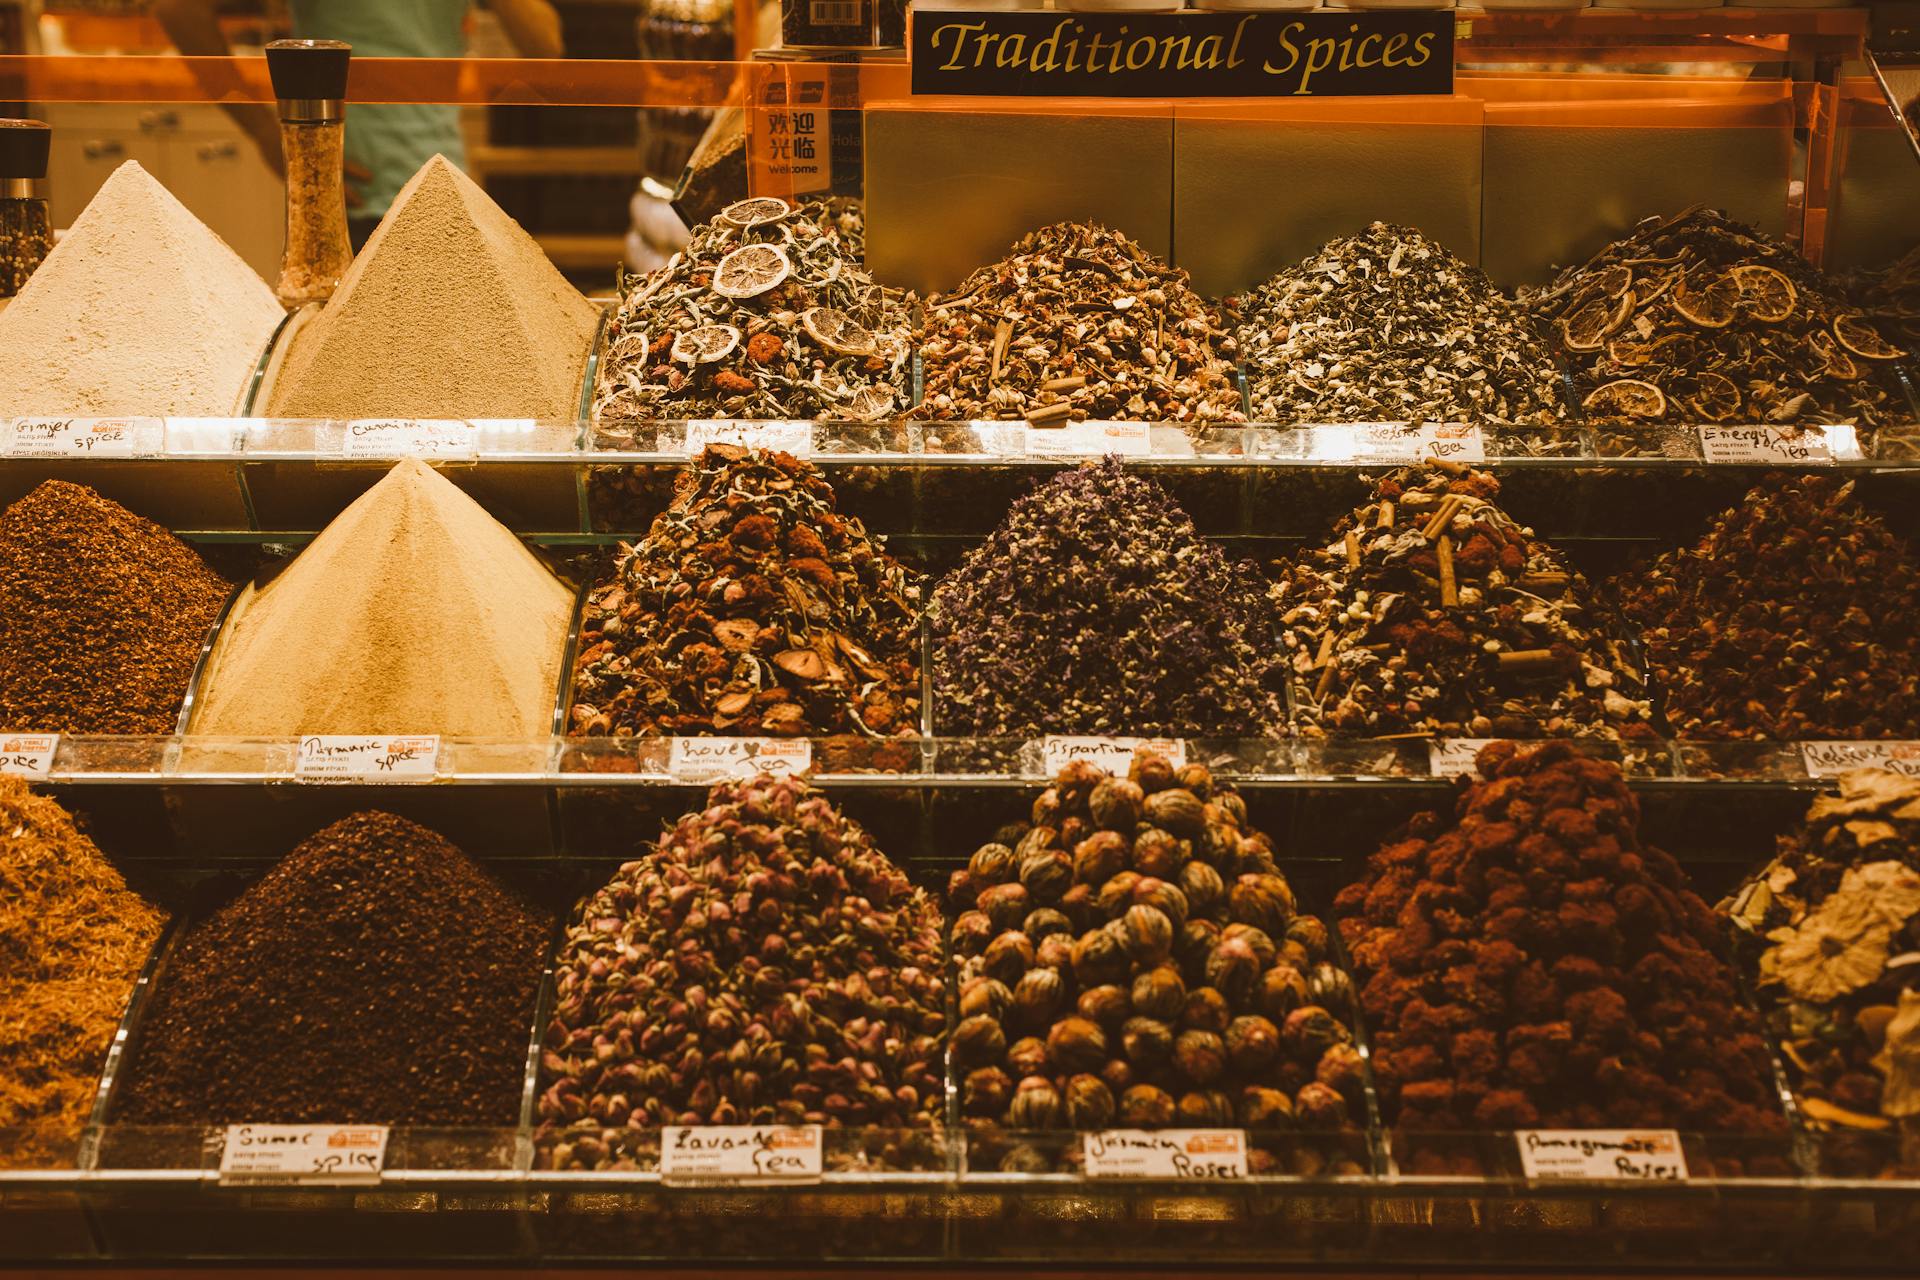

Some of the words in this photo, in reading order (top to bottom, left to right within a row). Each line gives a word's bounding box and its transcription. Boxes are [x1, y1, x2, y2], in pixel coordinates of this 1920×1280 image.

[931, 15, 1258, 74] Traditional
[1262, 22, 1436, 95] Spices
[768, 112, 815, 135] 欢迎
[770, 137, 815, 160] 光临
[768, 164, 818, 174] Welcome
[1704, 427, 1770, 448] Energy
[1771, 437, 1809, 459] Tea
[682, 739, 739, 757] Love
[0, 755, 38, 771] pice
[736, 754, 792, 771] Tea
[1172, 1153, 1239, 1179] Roses
